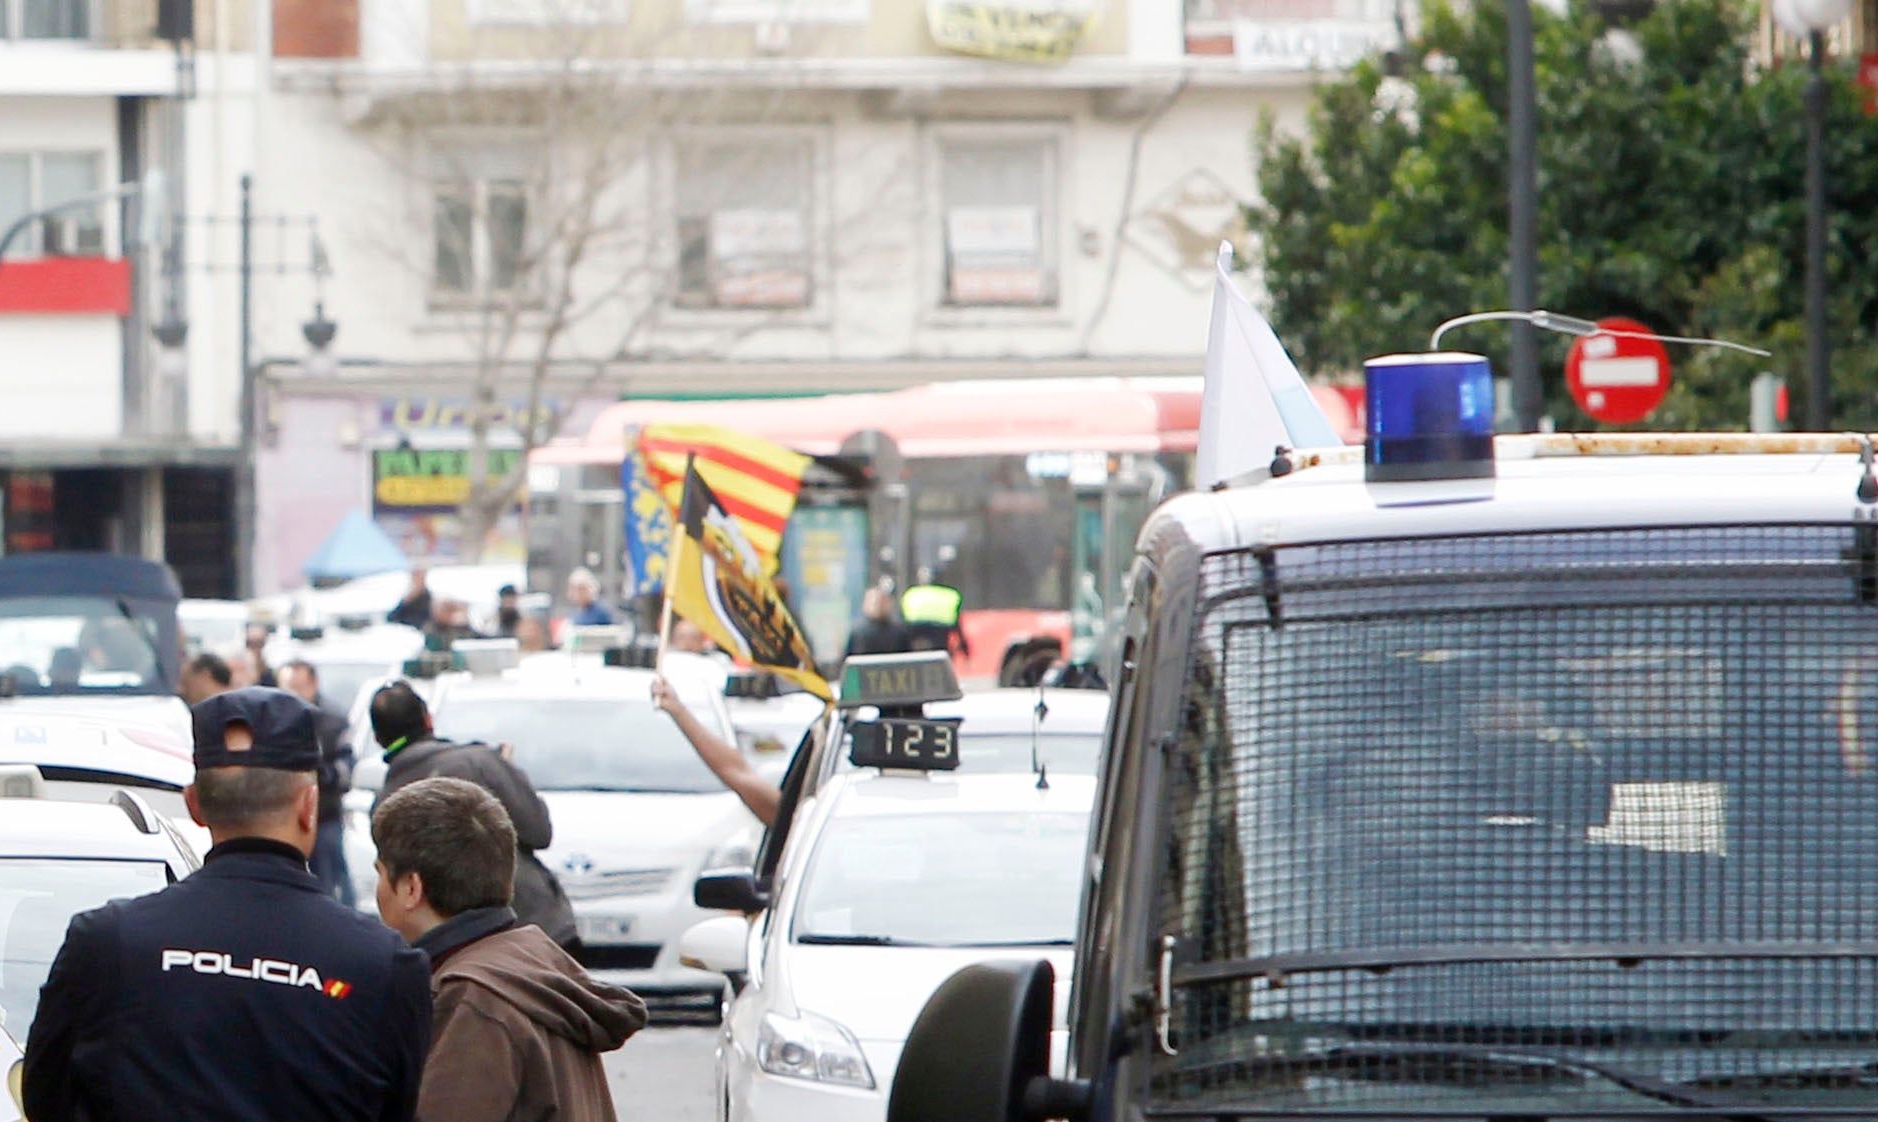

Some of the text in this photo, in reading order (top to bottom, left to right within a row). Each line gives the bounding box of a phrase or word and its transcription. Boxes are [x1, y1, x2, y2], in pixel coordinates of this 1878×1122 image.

[865, 666, 918, 694] TAXI
[883, 722, 953, 758] 123
[162, 949, 324, 991] POLICIA
